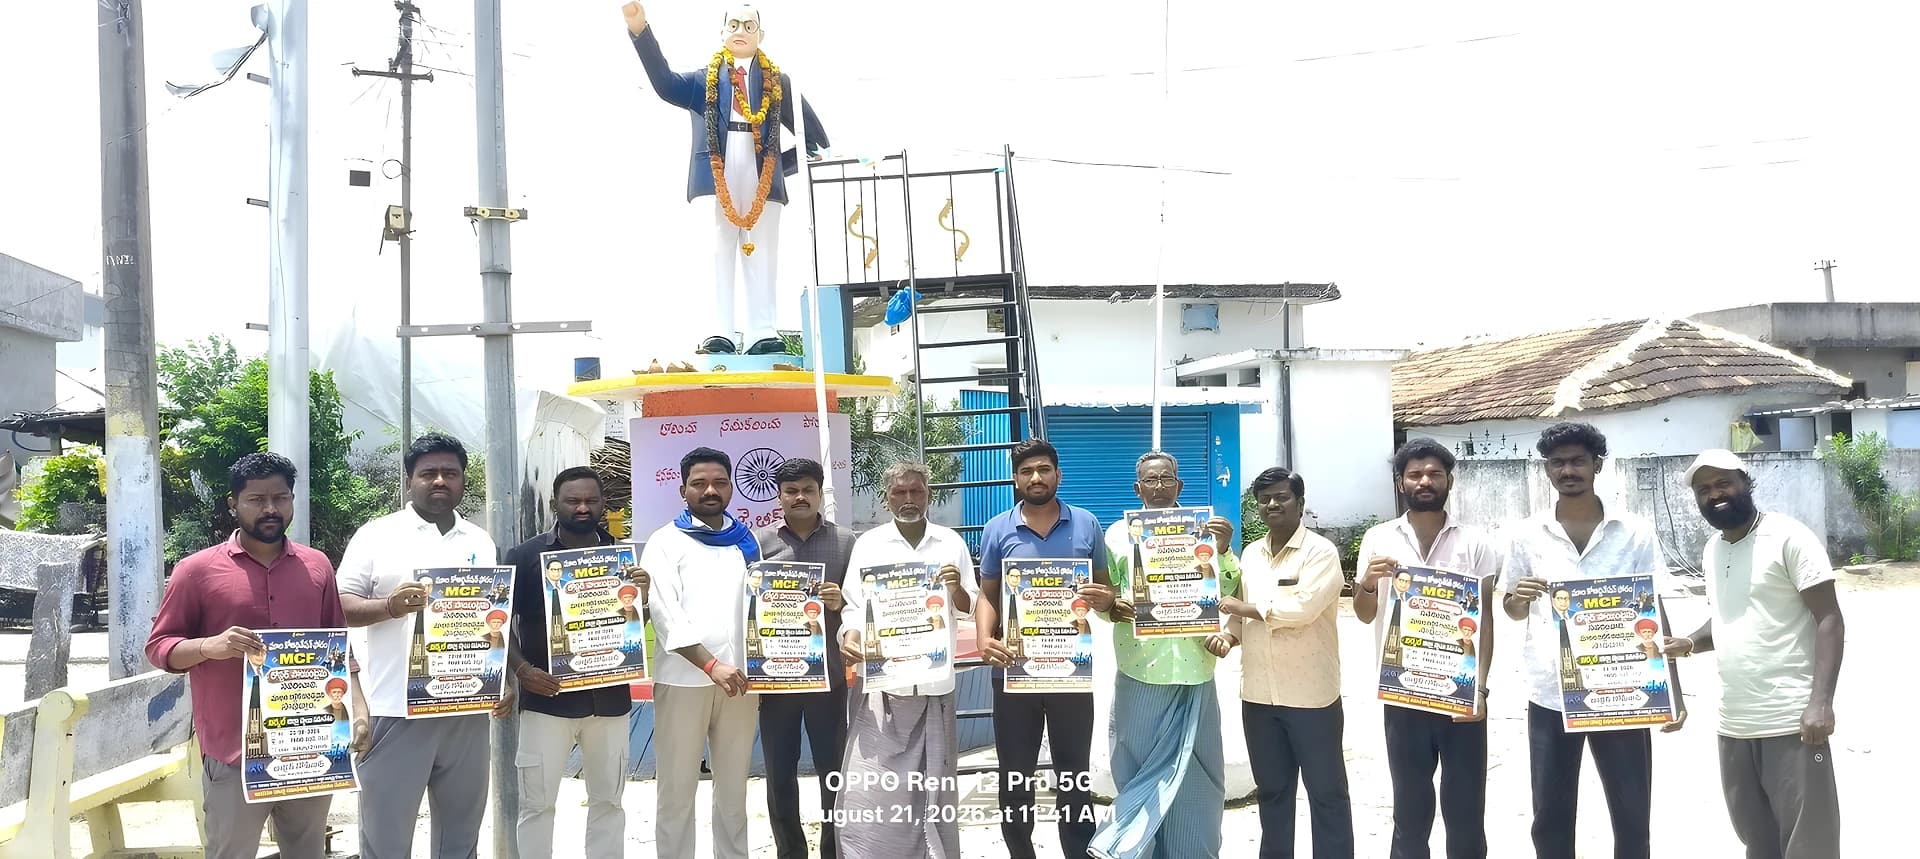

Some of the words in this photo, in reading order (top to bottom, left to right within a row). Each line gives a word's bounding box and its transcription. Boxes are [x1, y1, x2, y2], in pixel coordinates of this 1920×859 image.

[1154, 525, 1185, 536] MCF
[574, 566, 609, 578] MCF
[772, 579, 800, 589] MCF
[886, 577, 917, 590] MCF
[1031, 577, 1063, 587] MCF
[444, 586, 481, 597] MCF
[1422, 585, 1456, 600] MCF
[1583, 597, 1621, 609] MCF
[279, 652, 316, 665] MCF
